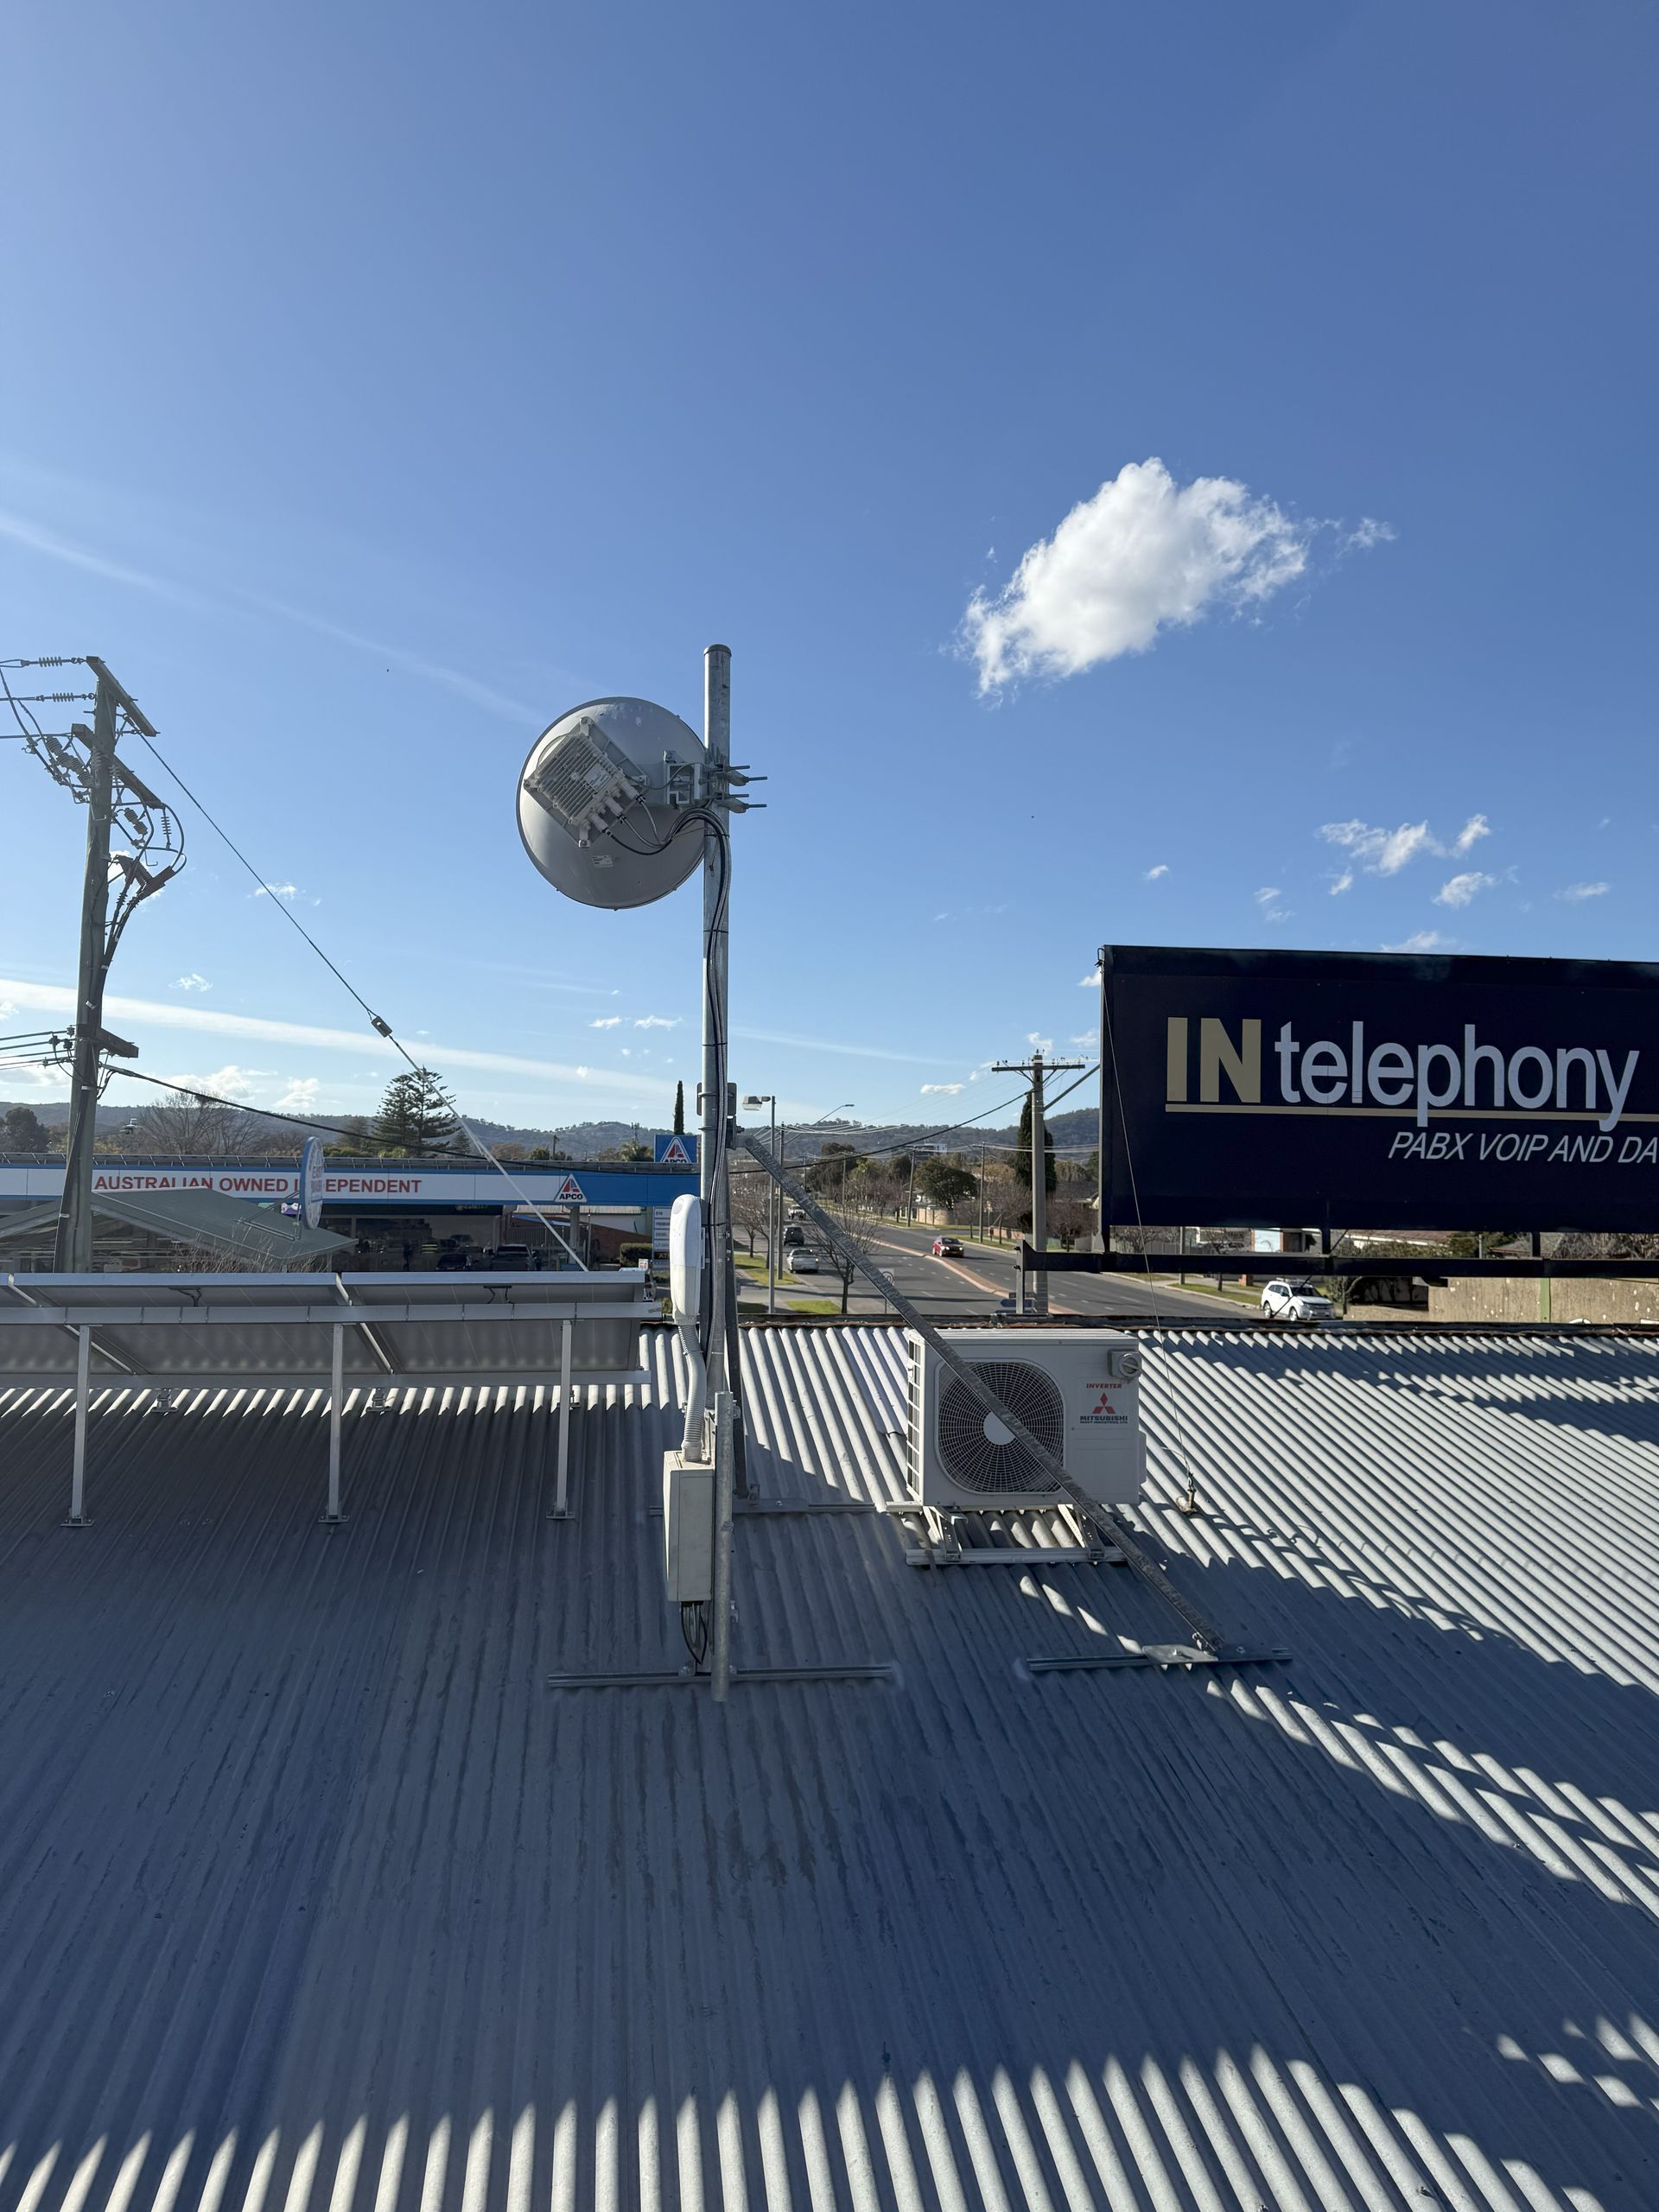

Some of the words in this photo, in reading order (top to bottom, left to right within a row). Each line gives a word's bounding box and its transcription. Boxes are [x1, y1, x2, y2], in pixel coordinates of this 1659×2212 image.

[1389, 1131, 1473, 1160] PABX
[1478, 1133, 1549, 1161] VOIP
[1548, 1135, 1614, 1163] AND
[219, 1177, 289, 1192] OWNED
[294, 1178, 422, 1193] IEPENDENT
